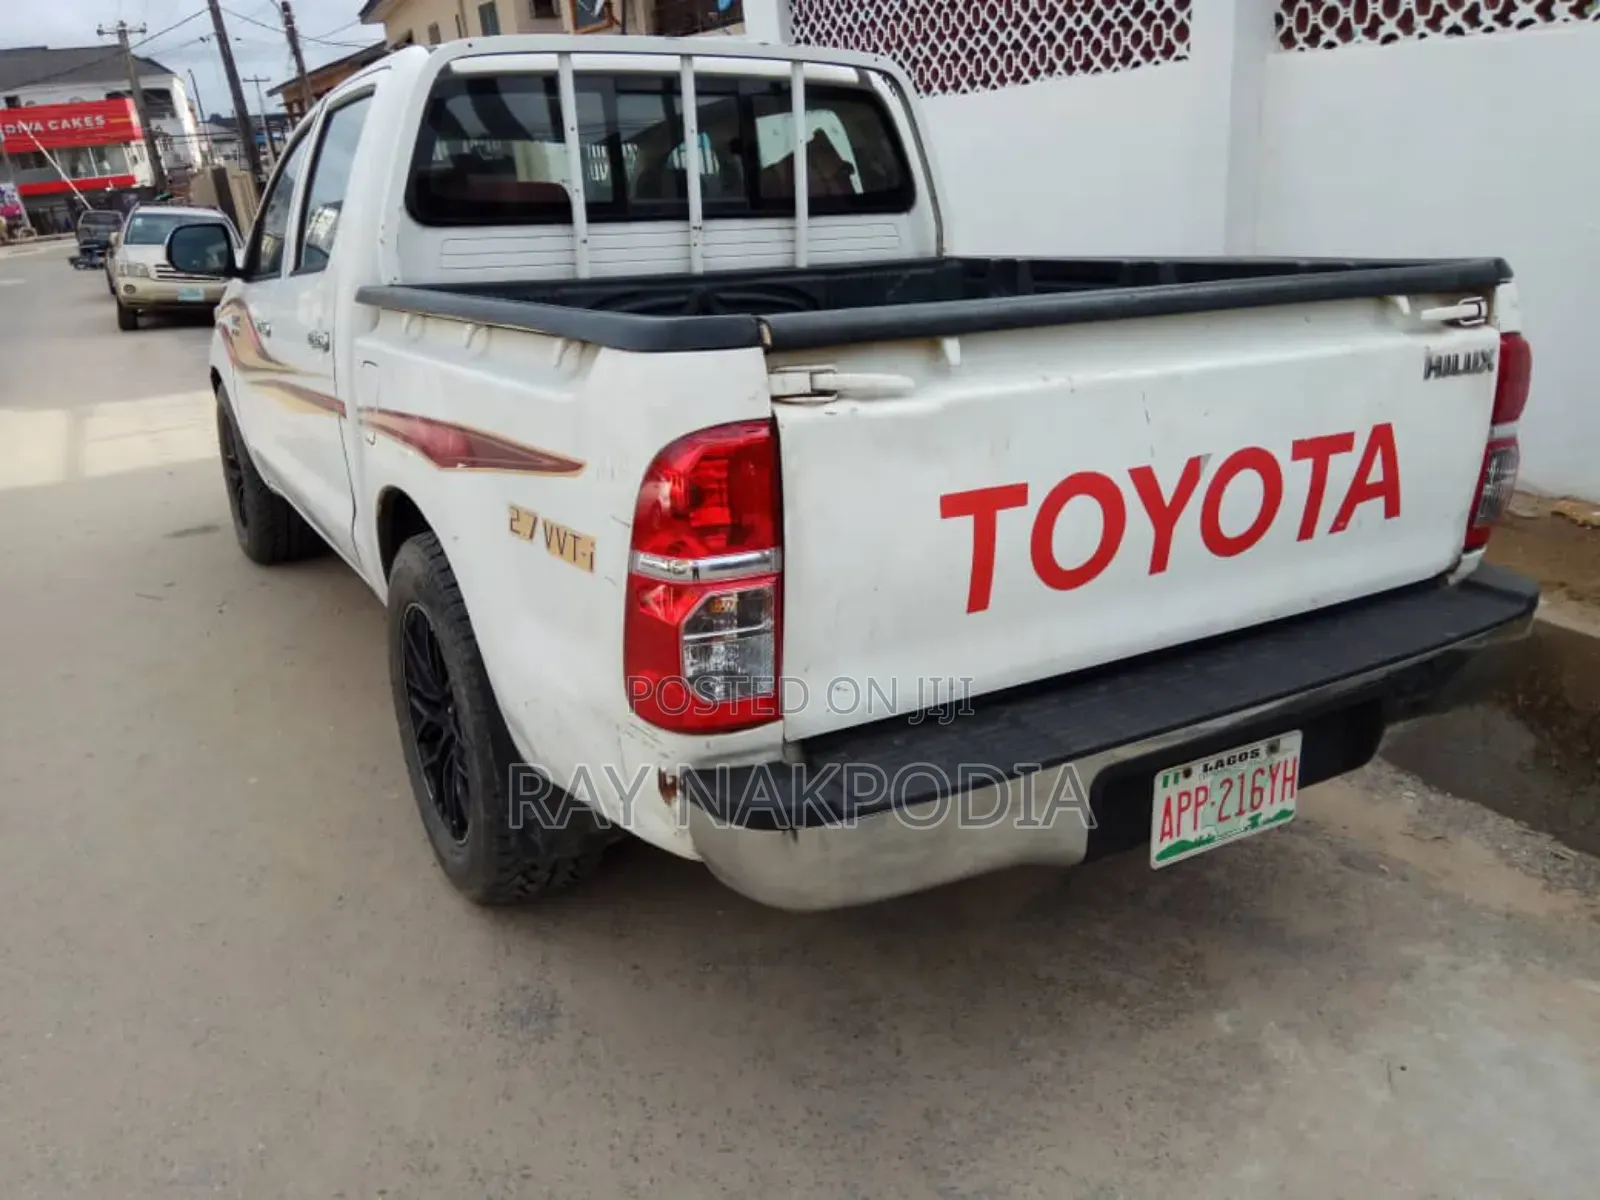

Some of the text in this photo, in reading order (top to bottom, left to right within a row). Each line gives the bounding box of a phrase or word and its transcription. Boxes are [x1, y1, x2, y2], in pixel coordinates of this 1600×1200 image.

[48, 115, 105, 131] CAKES
[1423, 348, 1495, 380] HILUX
[940, 423, 1400, 614] TOYOTA
[1202, 748, 1261, 773] LAGOS
